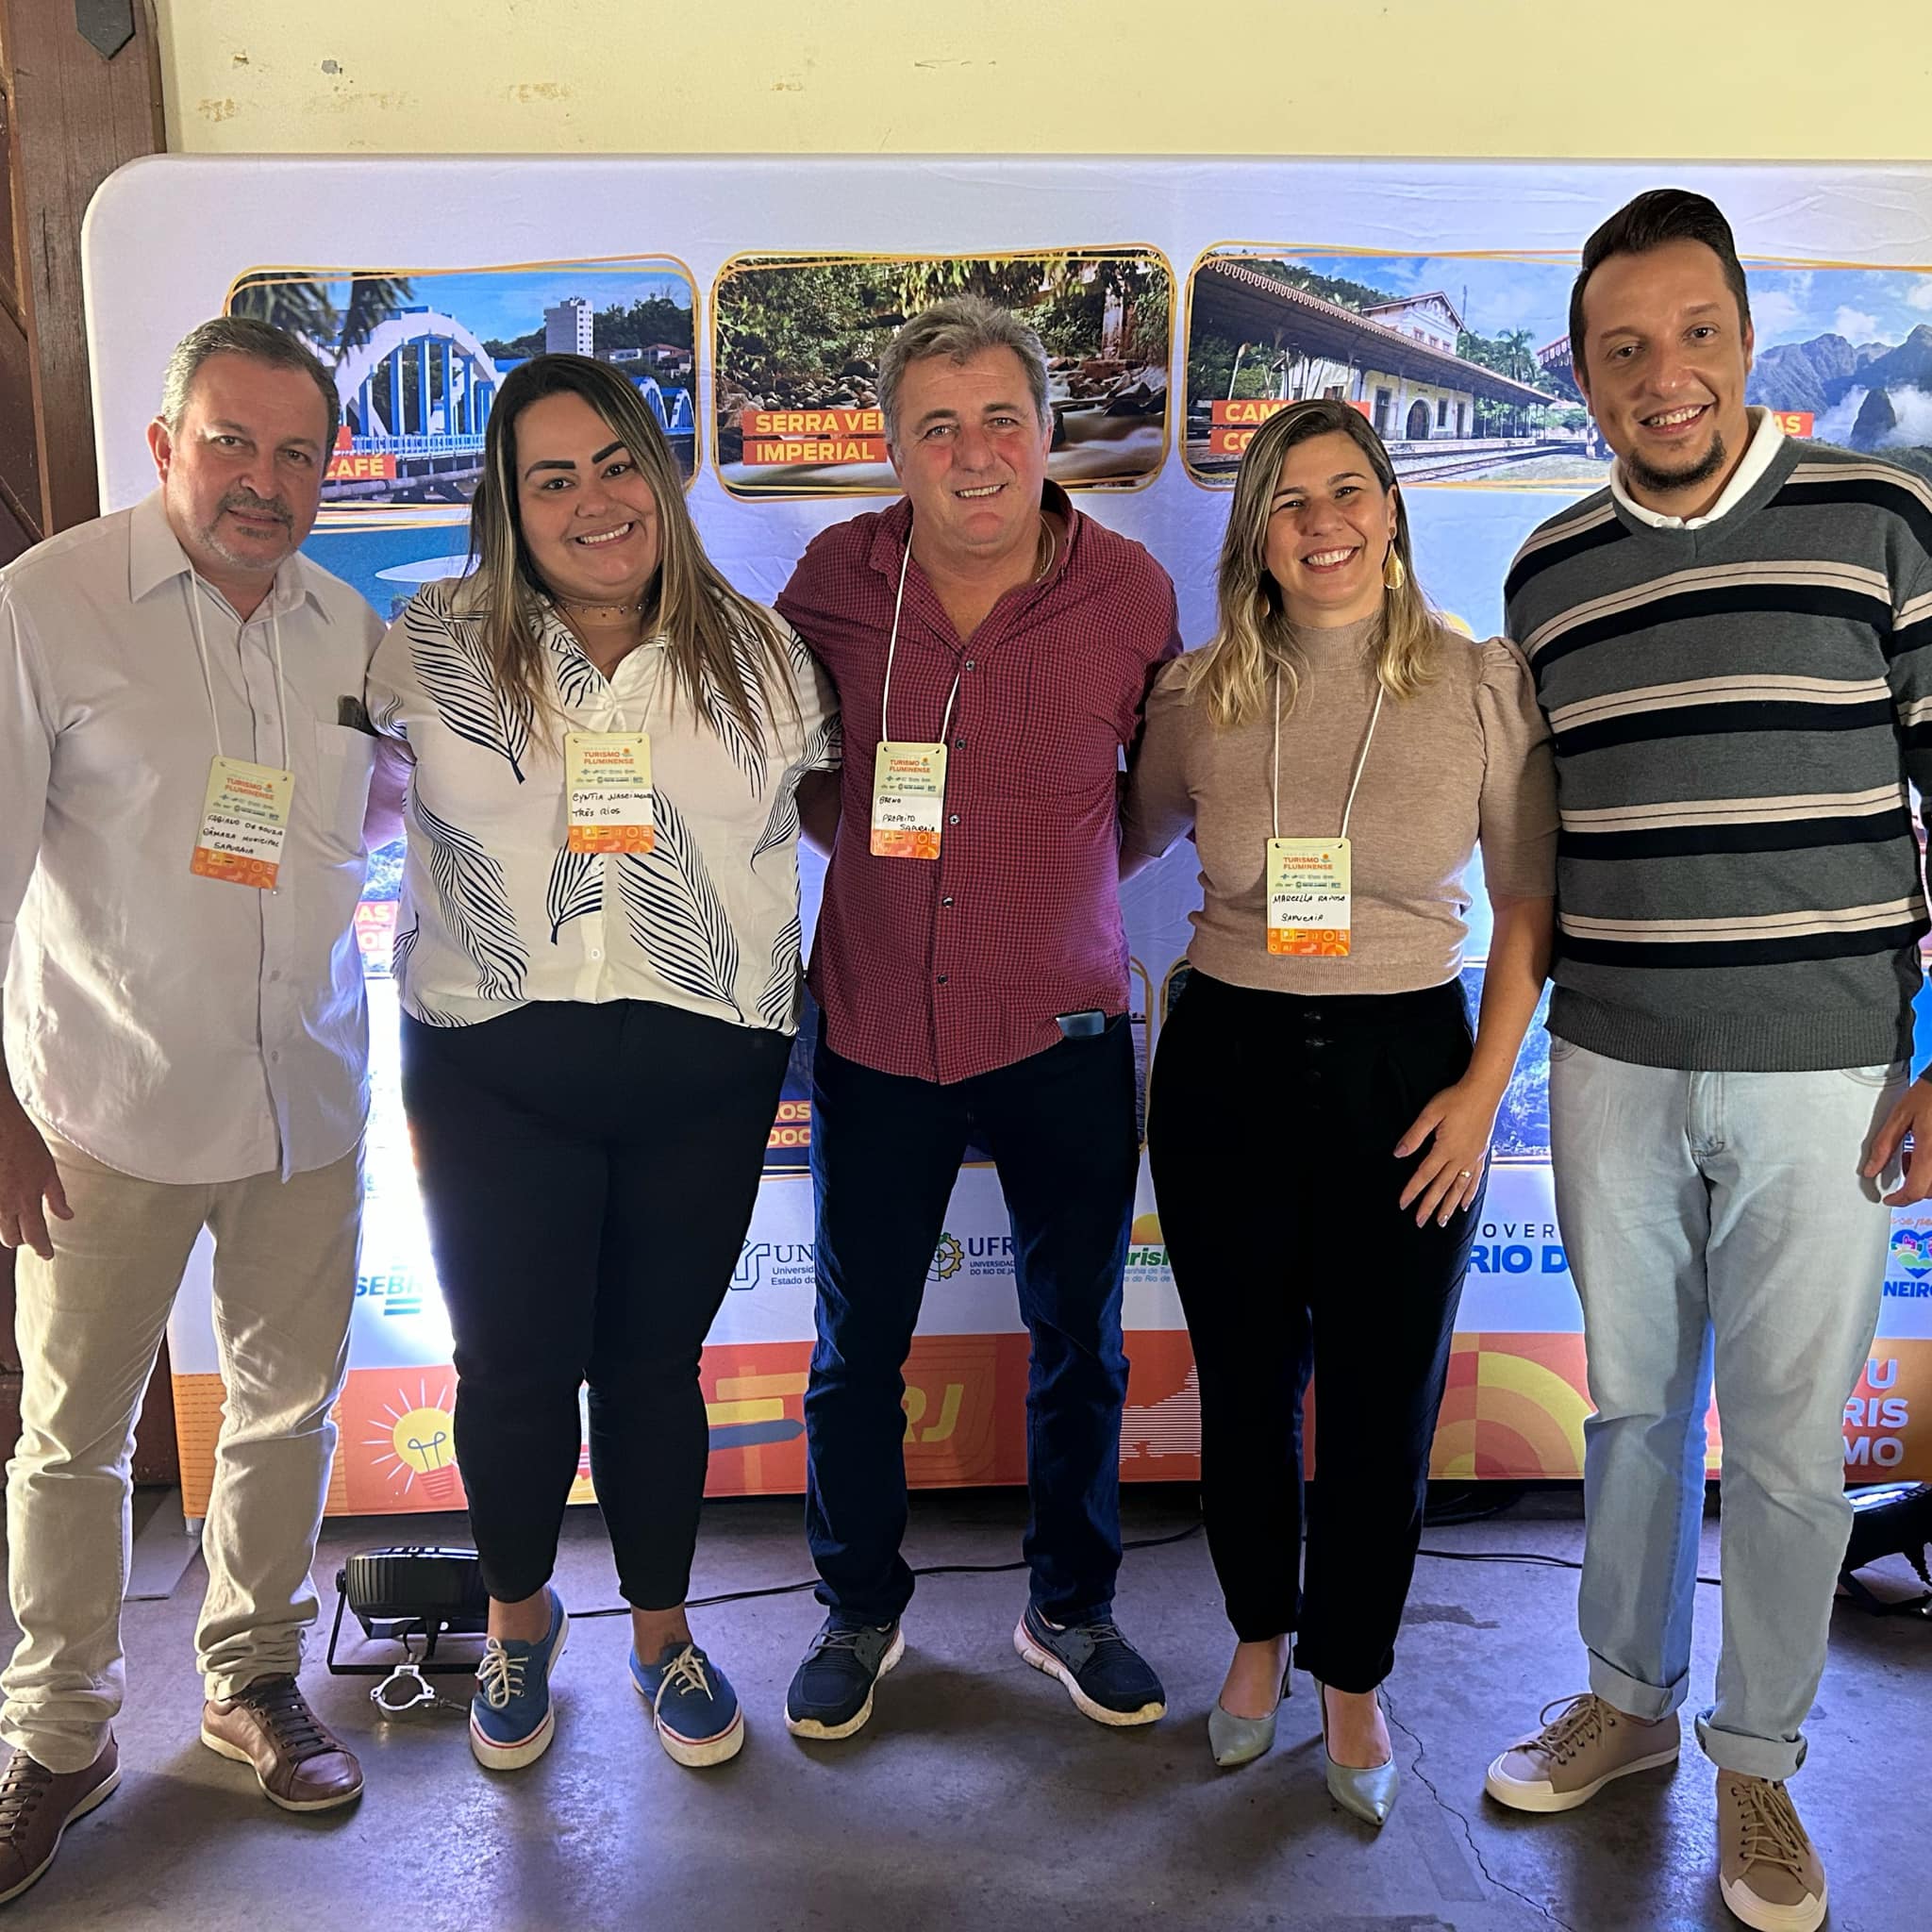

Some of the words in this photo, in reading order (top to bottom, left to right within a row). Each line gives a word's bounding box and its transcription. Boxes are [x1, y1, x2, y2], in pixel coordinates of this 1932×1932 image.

[1225, 403, 1284, 422] CAM
[756, 413, 839, 432] SERRA
[757, 441, 875, 461] IMPERIAL
[1482, 1223, 1556, 1239] OVER
[1467, 1244, 1532, 1274] RIO
[1541, 1244, 1568, 1274] D
[772, 1265, 815, 1275] Universid
[1883, 1281, 1932, 1298] NEIR
[1842, 1397, 1909, 1428] RIS
[1842, 1436, 1904, 1467] MO
